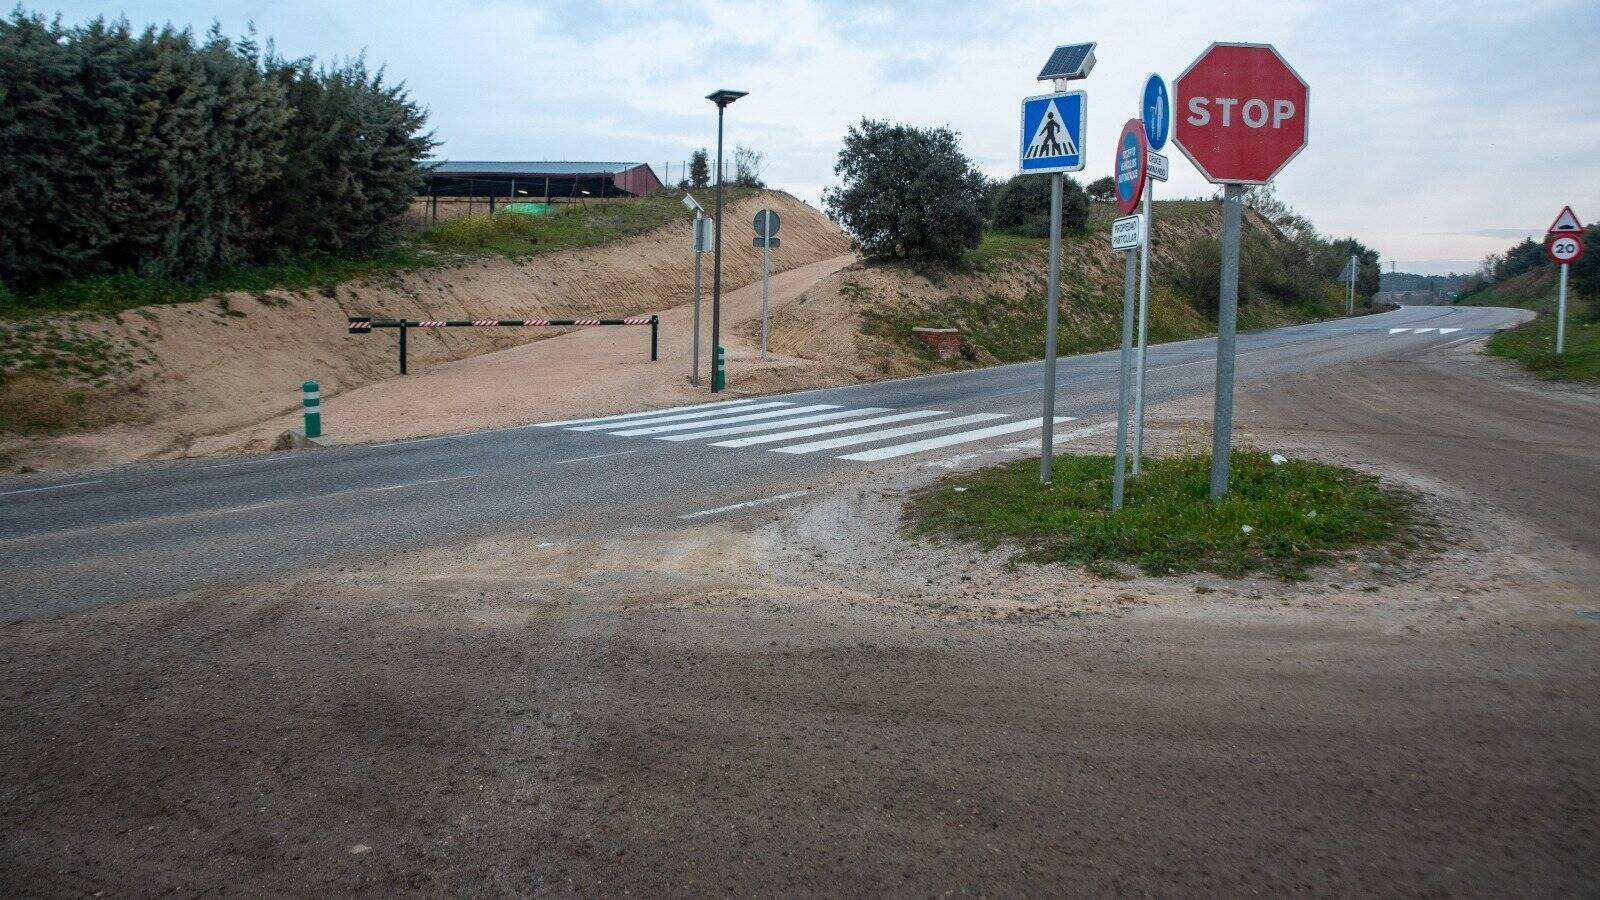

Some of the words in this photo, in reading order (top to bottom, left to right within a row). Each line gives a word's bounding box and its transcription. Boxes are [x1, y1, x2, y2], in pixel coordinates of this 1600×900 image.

[1186, 96, 1295, 128] STOP
[1149, 154, 1162, 165] CRUCE
[1114, 221, 1137, 233] PROPIEDAD
[1113, 233, 1137, 245] PARTICULAR
[1555, 243, 1575, 254] 20
